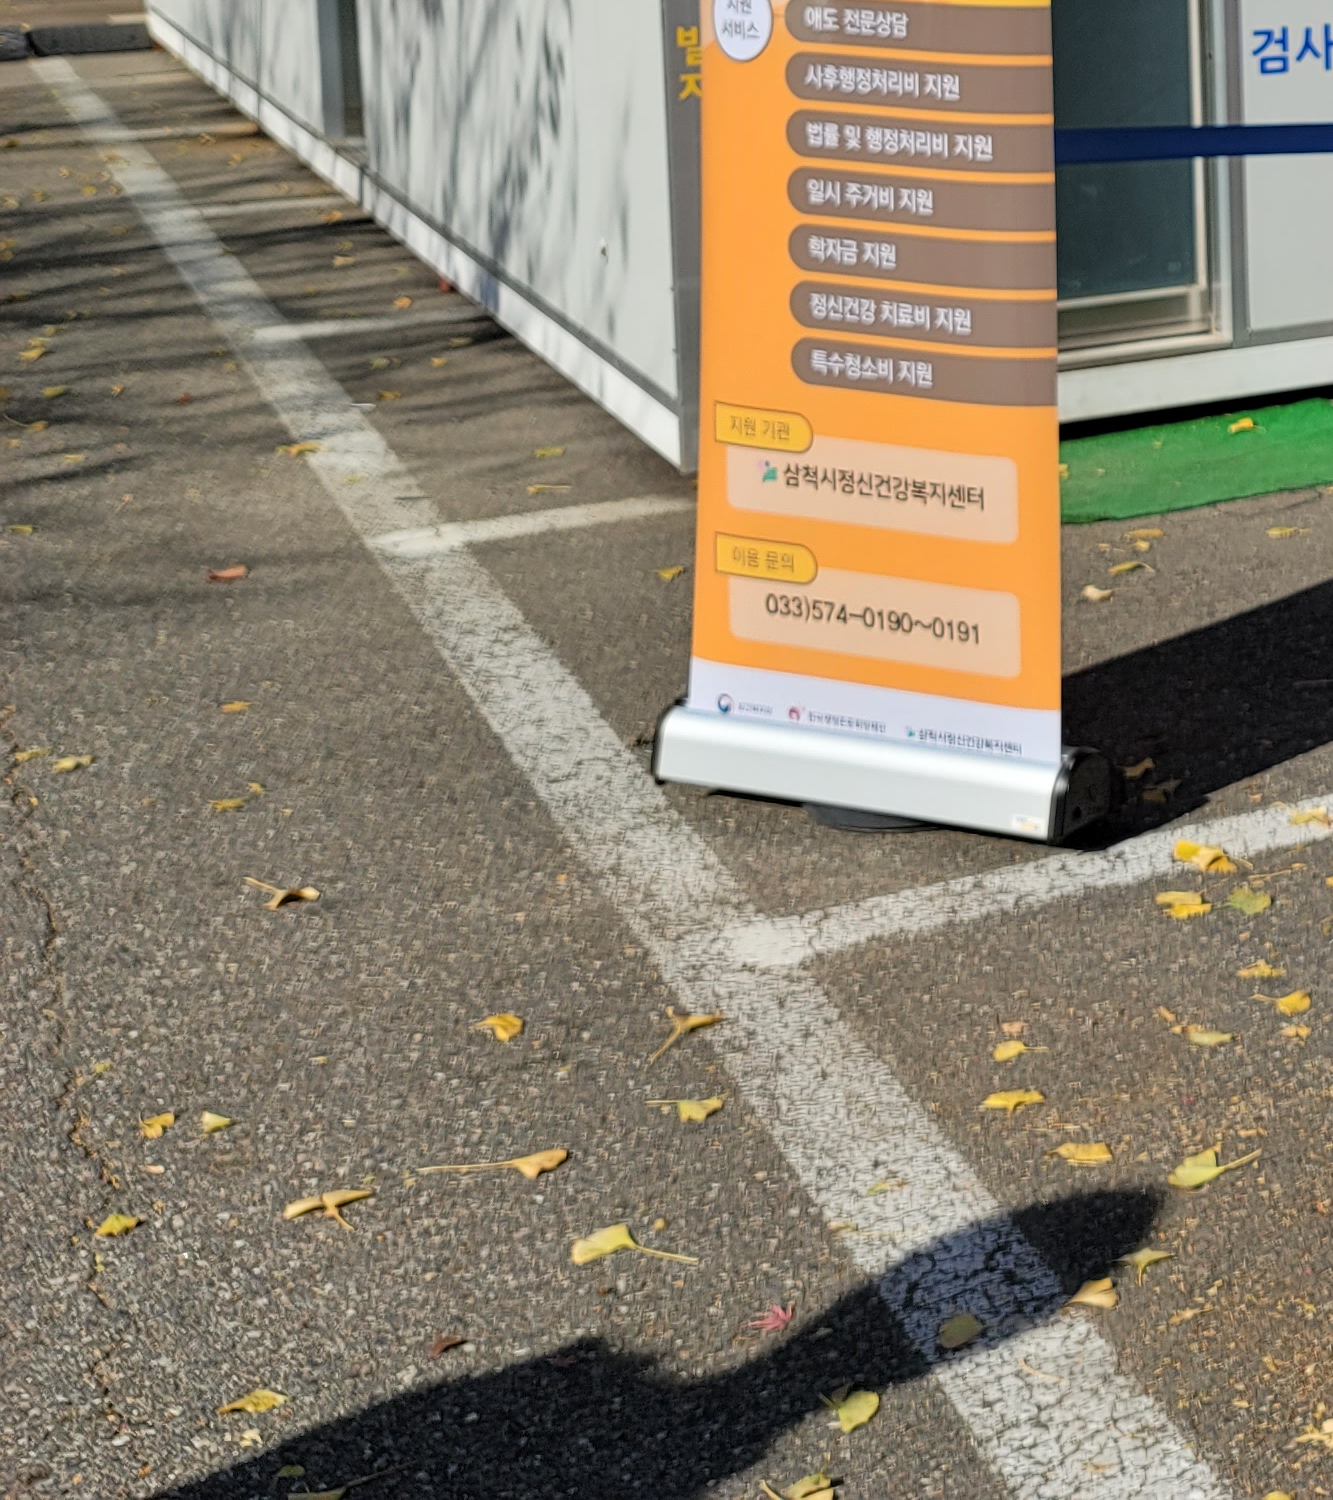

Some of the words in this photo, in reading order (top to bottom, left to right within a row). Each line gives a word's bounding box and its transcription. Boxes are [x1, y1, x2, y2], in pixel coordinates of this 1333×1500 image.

[721, 18, 760, 40] 서비스
[805, 6, 840, 32] 애도
[843, 8, 909, 39] 전문상담
[804, 62, 920, 100] 사후행정처리비
[924, 74, 961, 102] 지원
[805, 119, 840, 148] 법률
[844, 123, 863, 152] 및
[865, 125, 949, 159] 행정처리비
[953, 134, 994, 162] 지원
[806, 178, 842, 206] 일시
[845, 181, 895, 212] 주거비
[899, 187, 934, 217] 지원
[808, 236, 859, 265] 학자금
[863, 242, 898, 271] 지원
[809, 292, 876, 325] 정신건강
[879, 299, 932, 332] 치료비
[934, 305, 973, 335] 지원
[809, 348, 895, 384] 특수청소비
[898, 359, 934, 388] 지원
[730, 415, 756, 438] 지원
[783, 462, 985, 512] 삼척시정신건강복지센터
[764, 550, 795, 573] 문의
